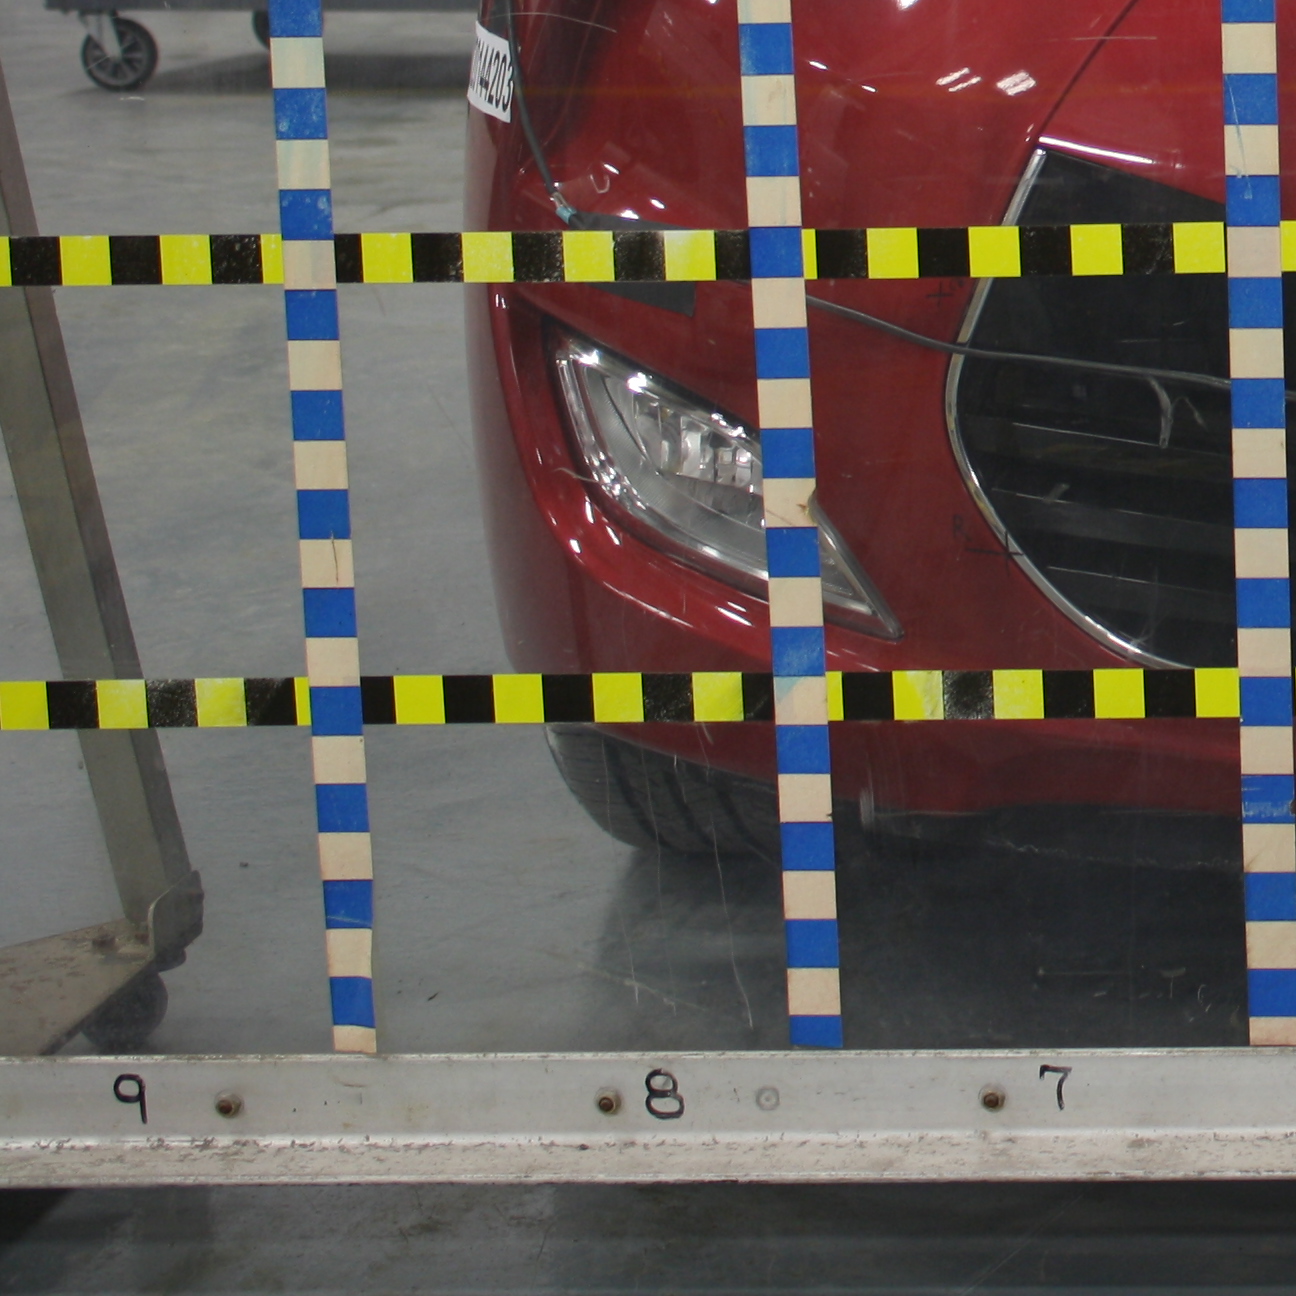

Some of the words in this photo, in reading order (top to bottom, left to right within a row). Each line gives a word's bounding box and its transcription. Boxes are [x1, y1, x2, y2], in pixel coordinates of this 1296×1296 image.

[113, 1073, 147, 1125] 9
[645, 1068, 684, 1120] 8
[1038, 1065, 1072, 1110] 7
